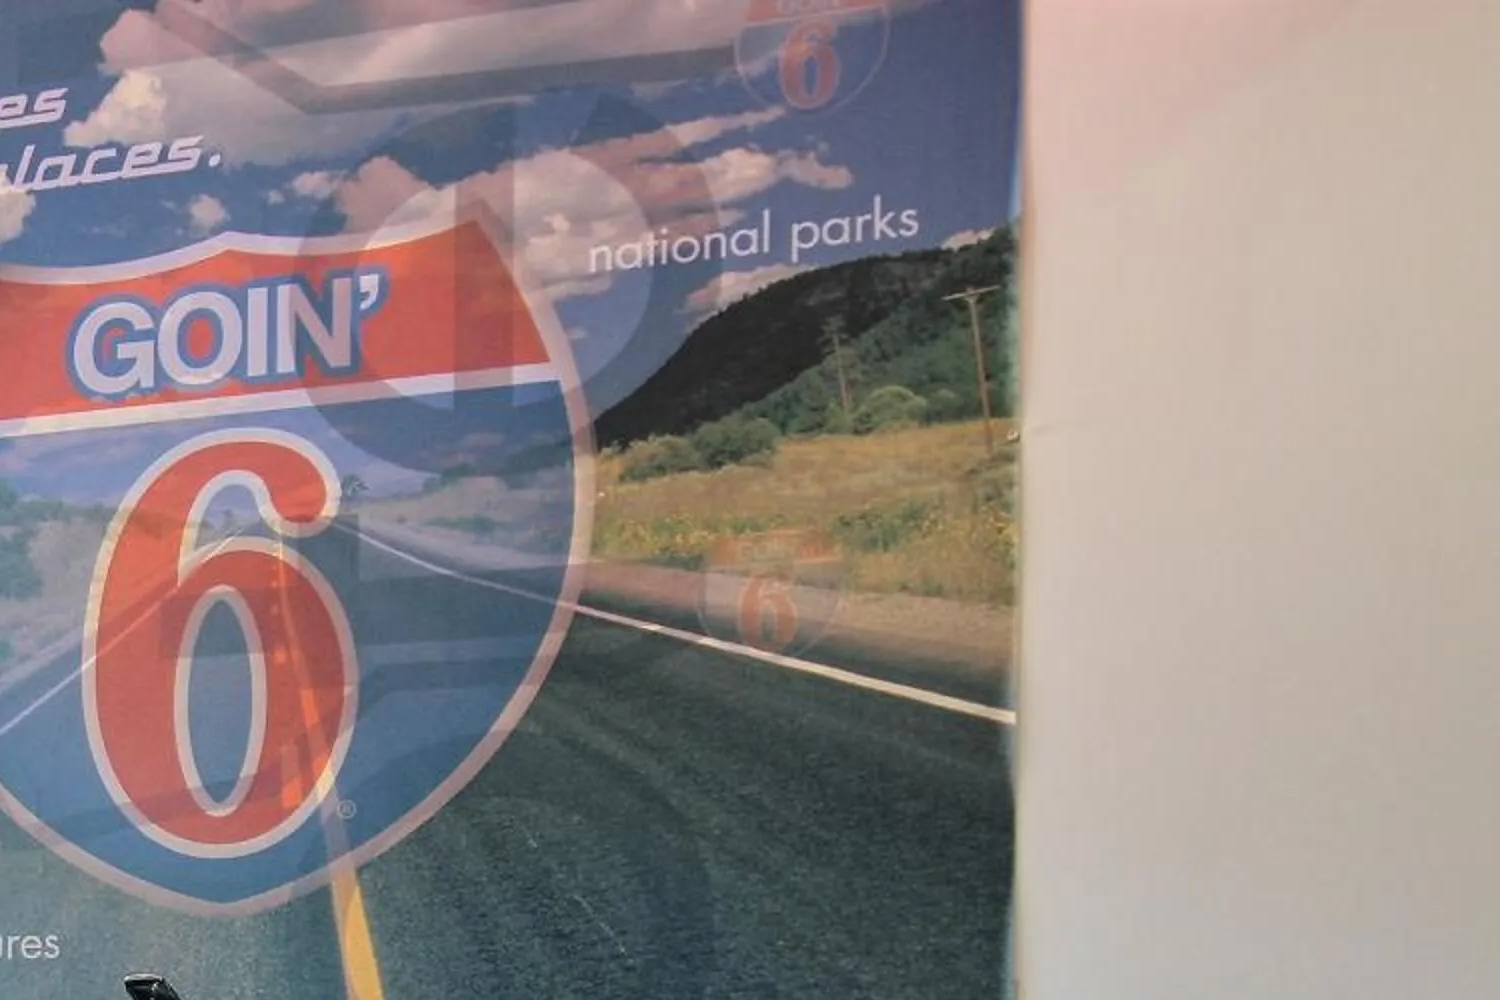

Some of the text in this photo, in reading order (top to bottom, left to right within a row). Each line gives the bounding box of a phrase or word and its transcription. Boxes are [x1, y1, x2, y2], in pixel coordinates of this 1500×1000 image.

[588, 194, 920, 274] national parks
[72, 272, 380, 396] GOIN'
[82, 428, 359, 858] 6
